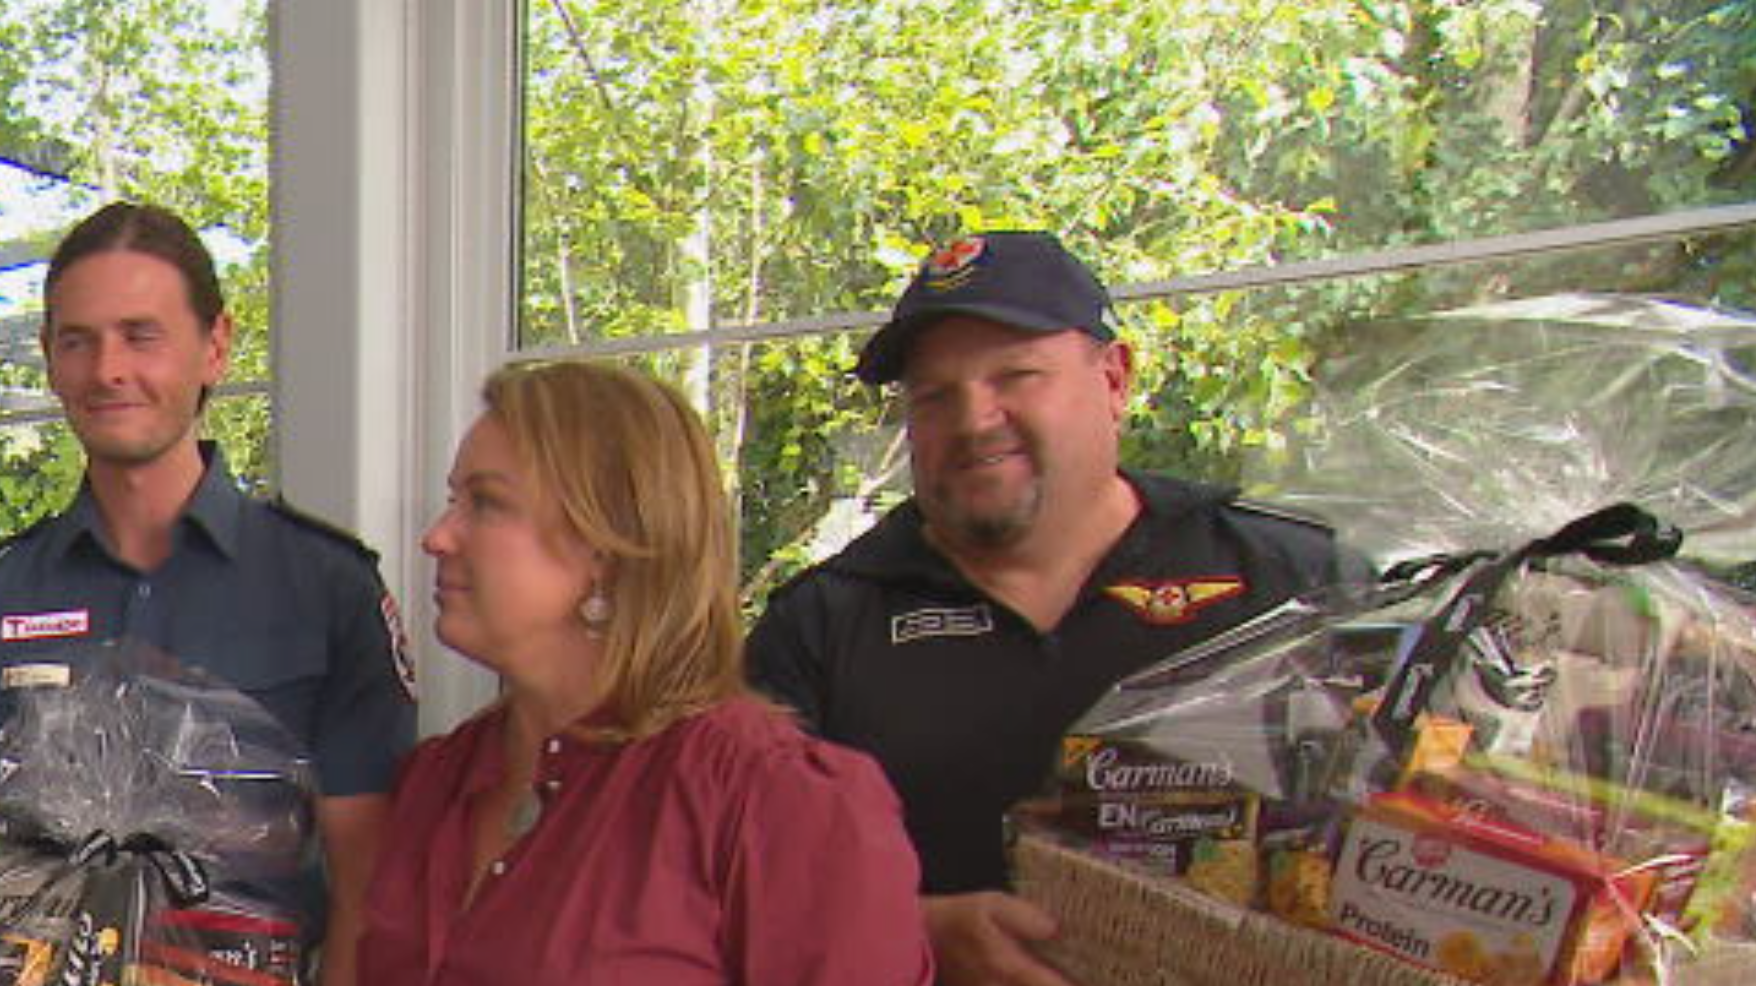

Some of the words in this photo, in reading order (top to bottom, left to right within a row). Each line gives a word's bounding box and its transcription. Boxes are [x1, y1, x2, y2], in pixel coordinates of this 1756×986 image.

[1086, 749, 1232, 789] Carman's
[1356, 838, 1554, 926] Carman's
[1340, 903, 1431, 957] Protein
